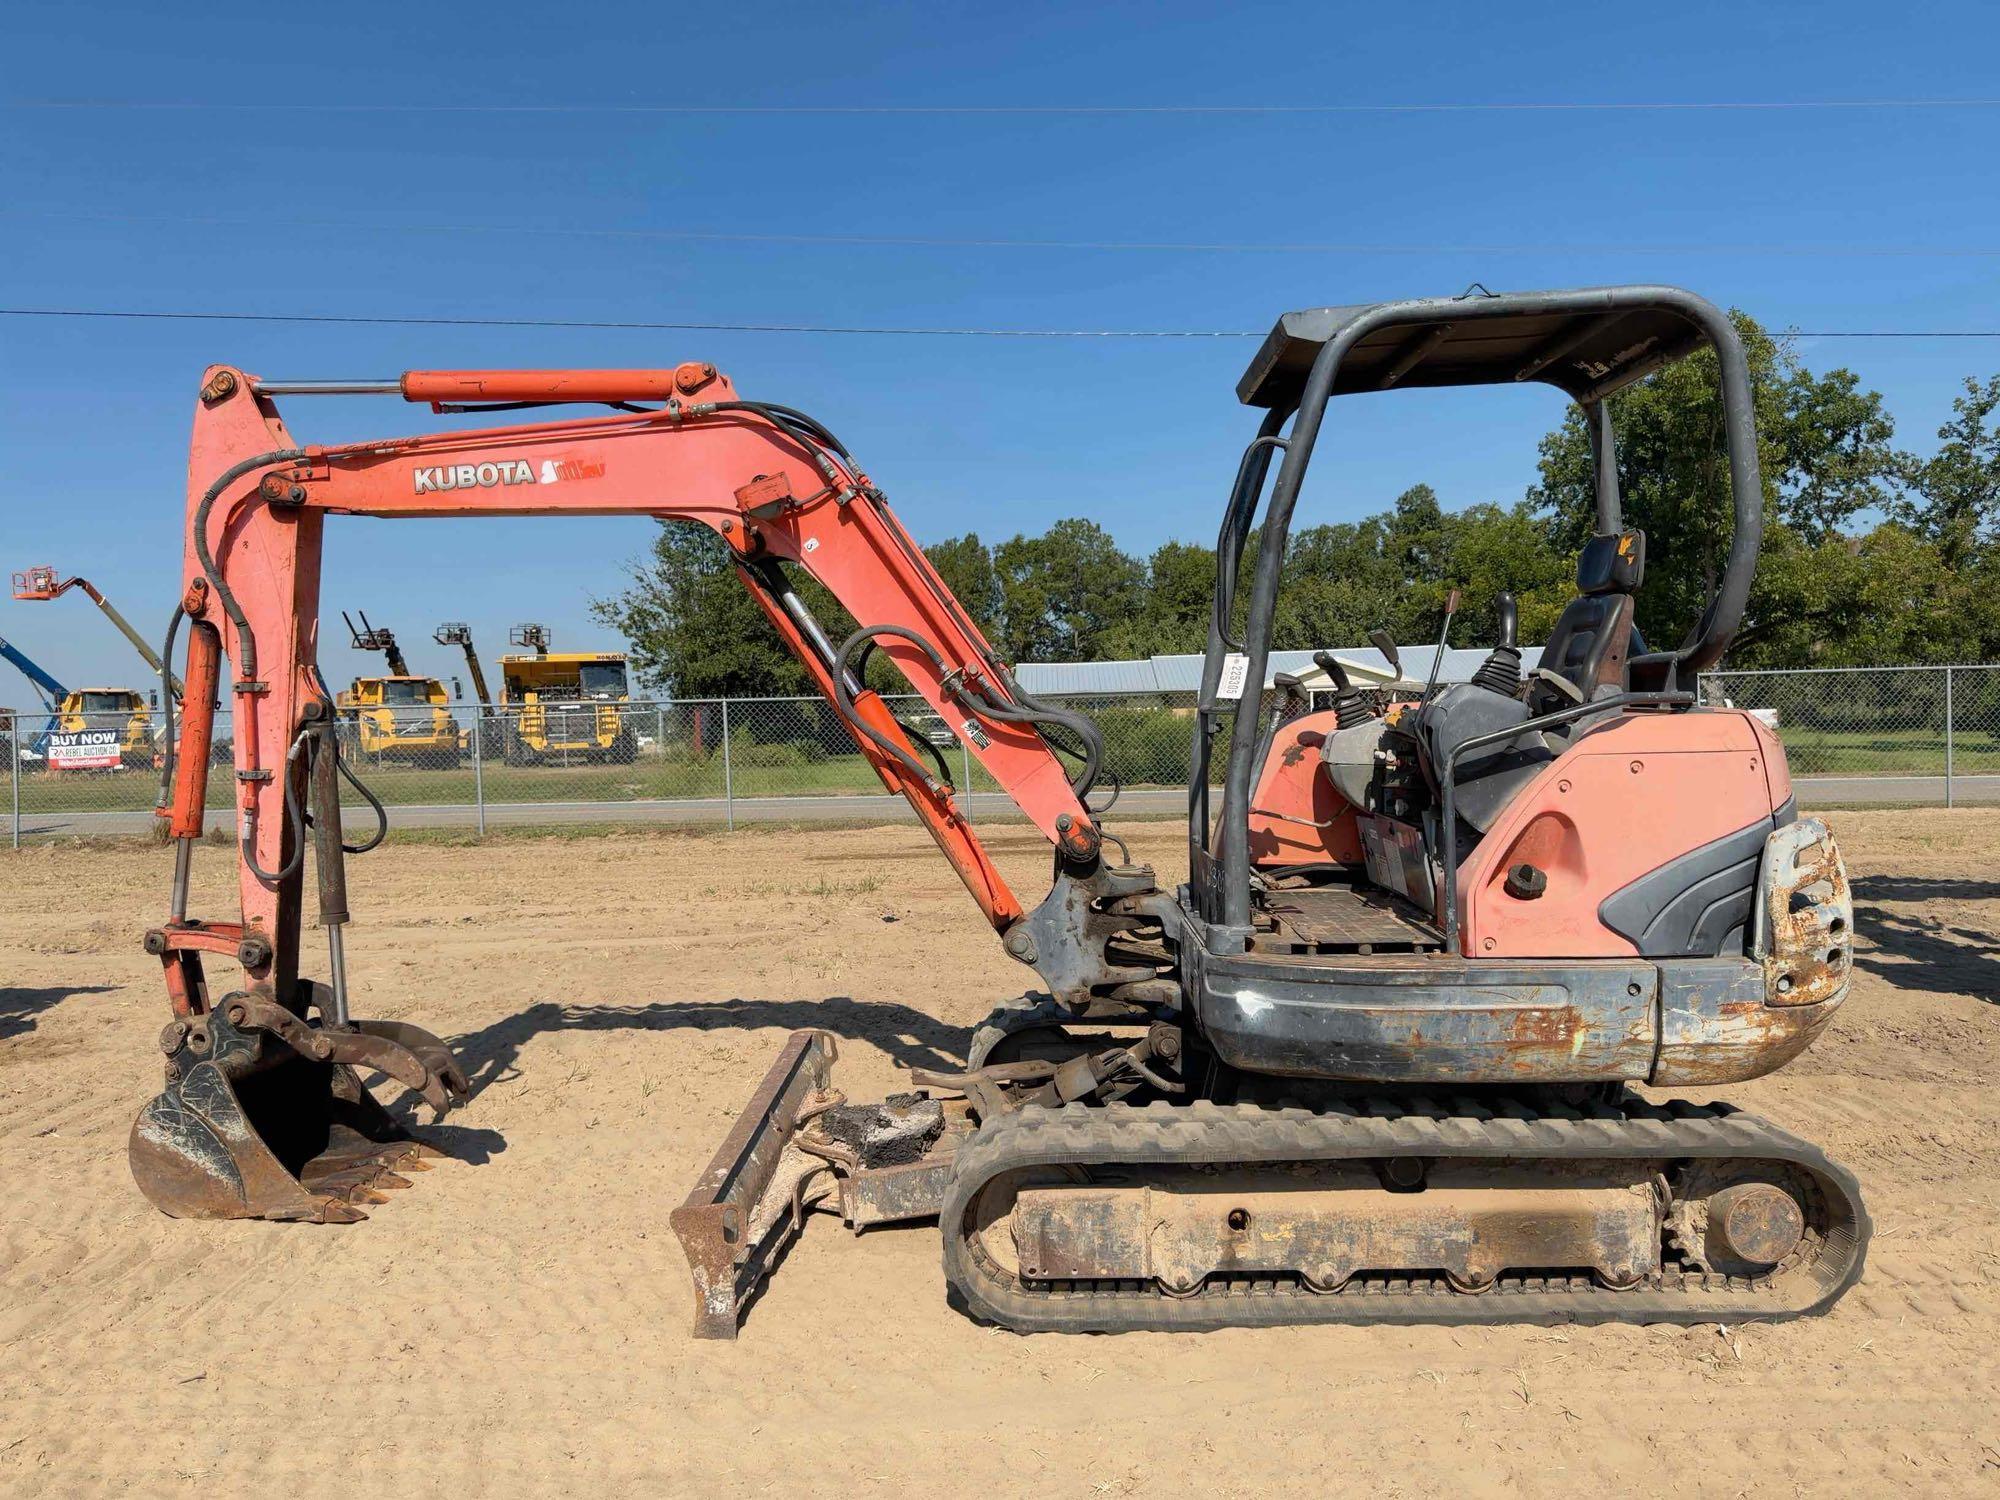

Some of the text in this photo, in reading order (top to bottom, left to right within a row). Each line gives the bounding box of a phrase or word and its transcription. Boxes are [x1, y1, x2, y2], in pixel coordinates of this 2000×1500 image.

[414, 460, 536, 492] KUBOTA
[1226, 665, 1243, 695] 225305
[51, 732, 117, 746] BUY NOW
[65, 748, 82, 757] REBEL
[83, 745, 109, 756] AUCTION
